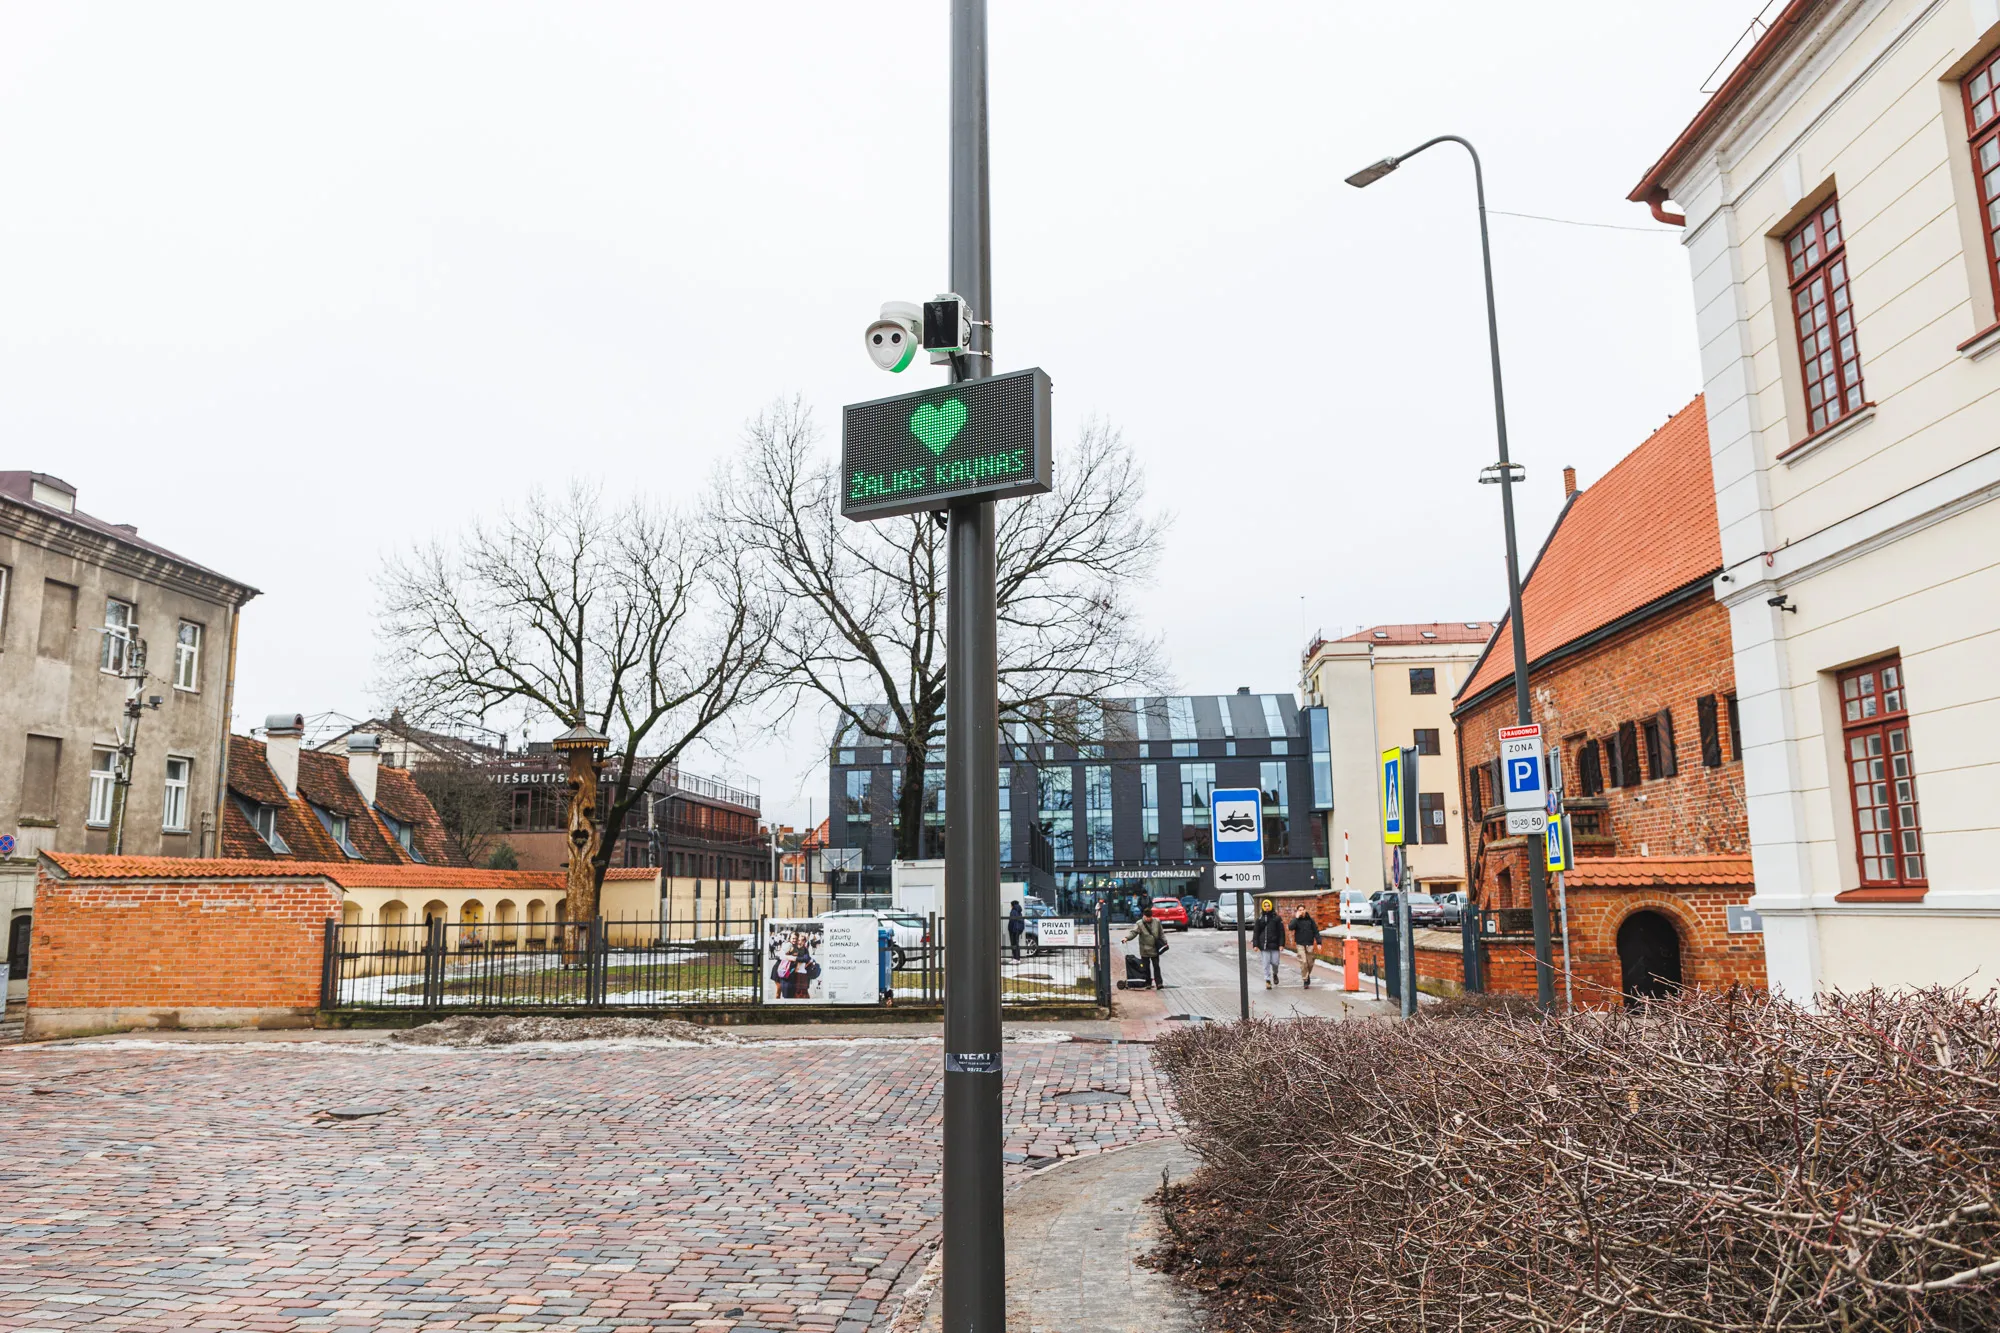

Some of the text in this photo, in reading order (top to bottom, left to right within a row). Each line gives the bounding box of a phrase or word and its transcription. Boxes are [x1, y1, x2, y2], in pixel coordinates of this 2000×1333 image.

[851, 449, 1025, 498] ŽALIAS KAUNAS
[1509, 743, 1533, 752] ZONA
[487, 773, 565, 784] VIEŠBUTIS
[1514, 761, 1532, 789] P
[1531, 817, 1542, 826] 50
[1151, 870, 1196, 878] GIMNAZIJA
[1235, 873, 1250, 882] 100
